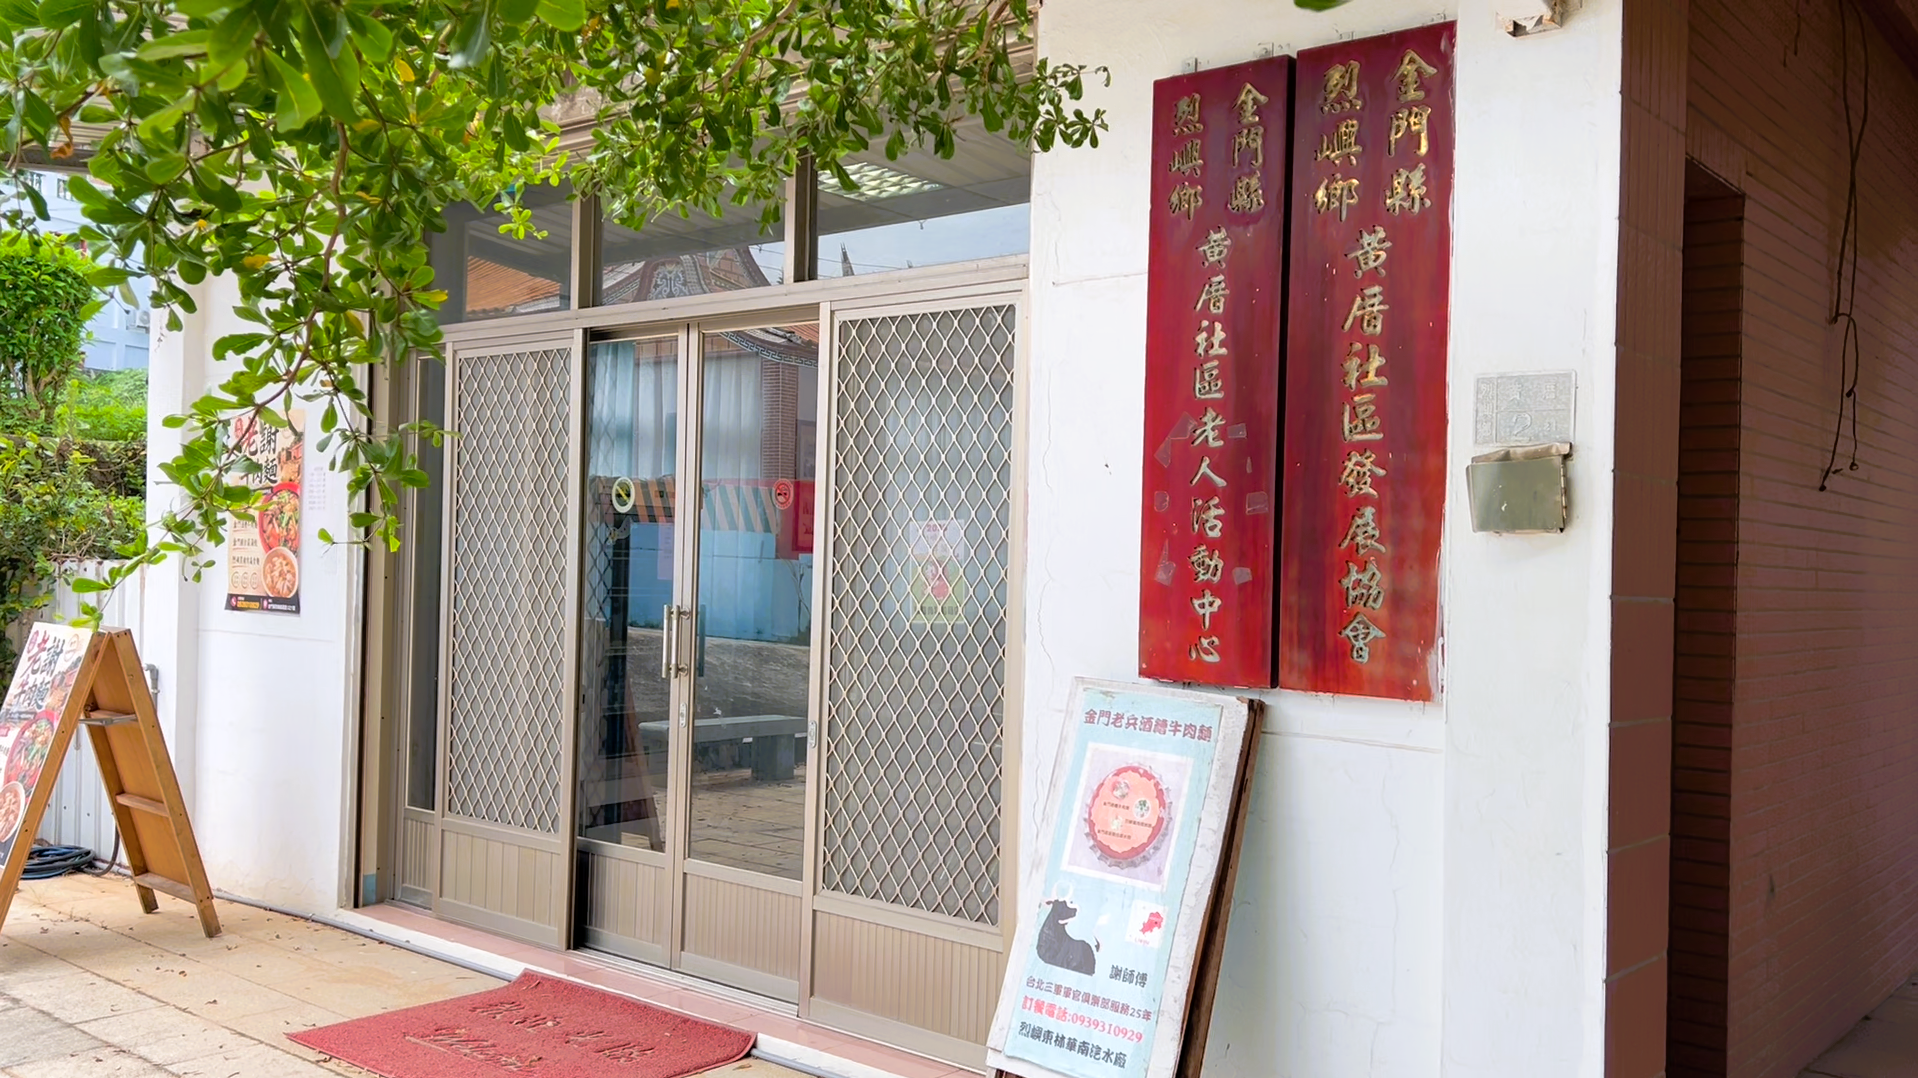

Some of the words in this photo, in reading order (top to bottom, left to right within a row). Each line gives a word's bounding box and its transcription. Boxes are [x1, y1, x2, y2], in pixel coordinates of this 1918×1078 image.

[1168, 92, 1204, 221] 烈嶼鄉
[1228, 81, 1269, 214] 金門縣
[1313, 59, 1363, 223] 烈嶼鄉
[1384, 48, 1438, 216] 金門縣
[1188, 224, 1231, 663] 黃厝社區老人活動中心
[1338, 224, 1393, 664] 黃厝社區發展協會
[13, 674, 51, 710] 牛肉麵
[20, 630, 66, 678] 老謝
[1022, 995, 1143, 1043] 訂餐電話:0939310929
[1026, 975, 1153, 1022] 台北三軍軍官俱樂部服務25年
[1109, 964, 1148, 988] 謝師傅
